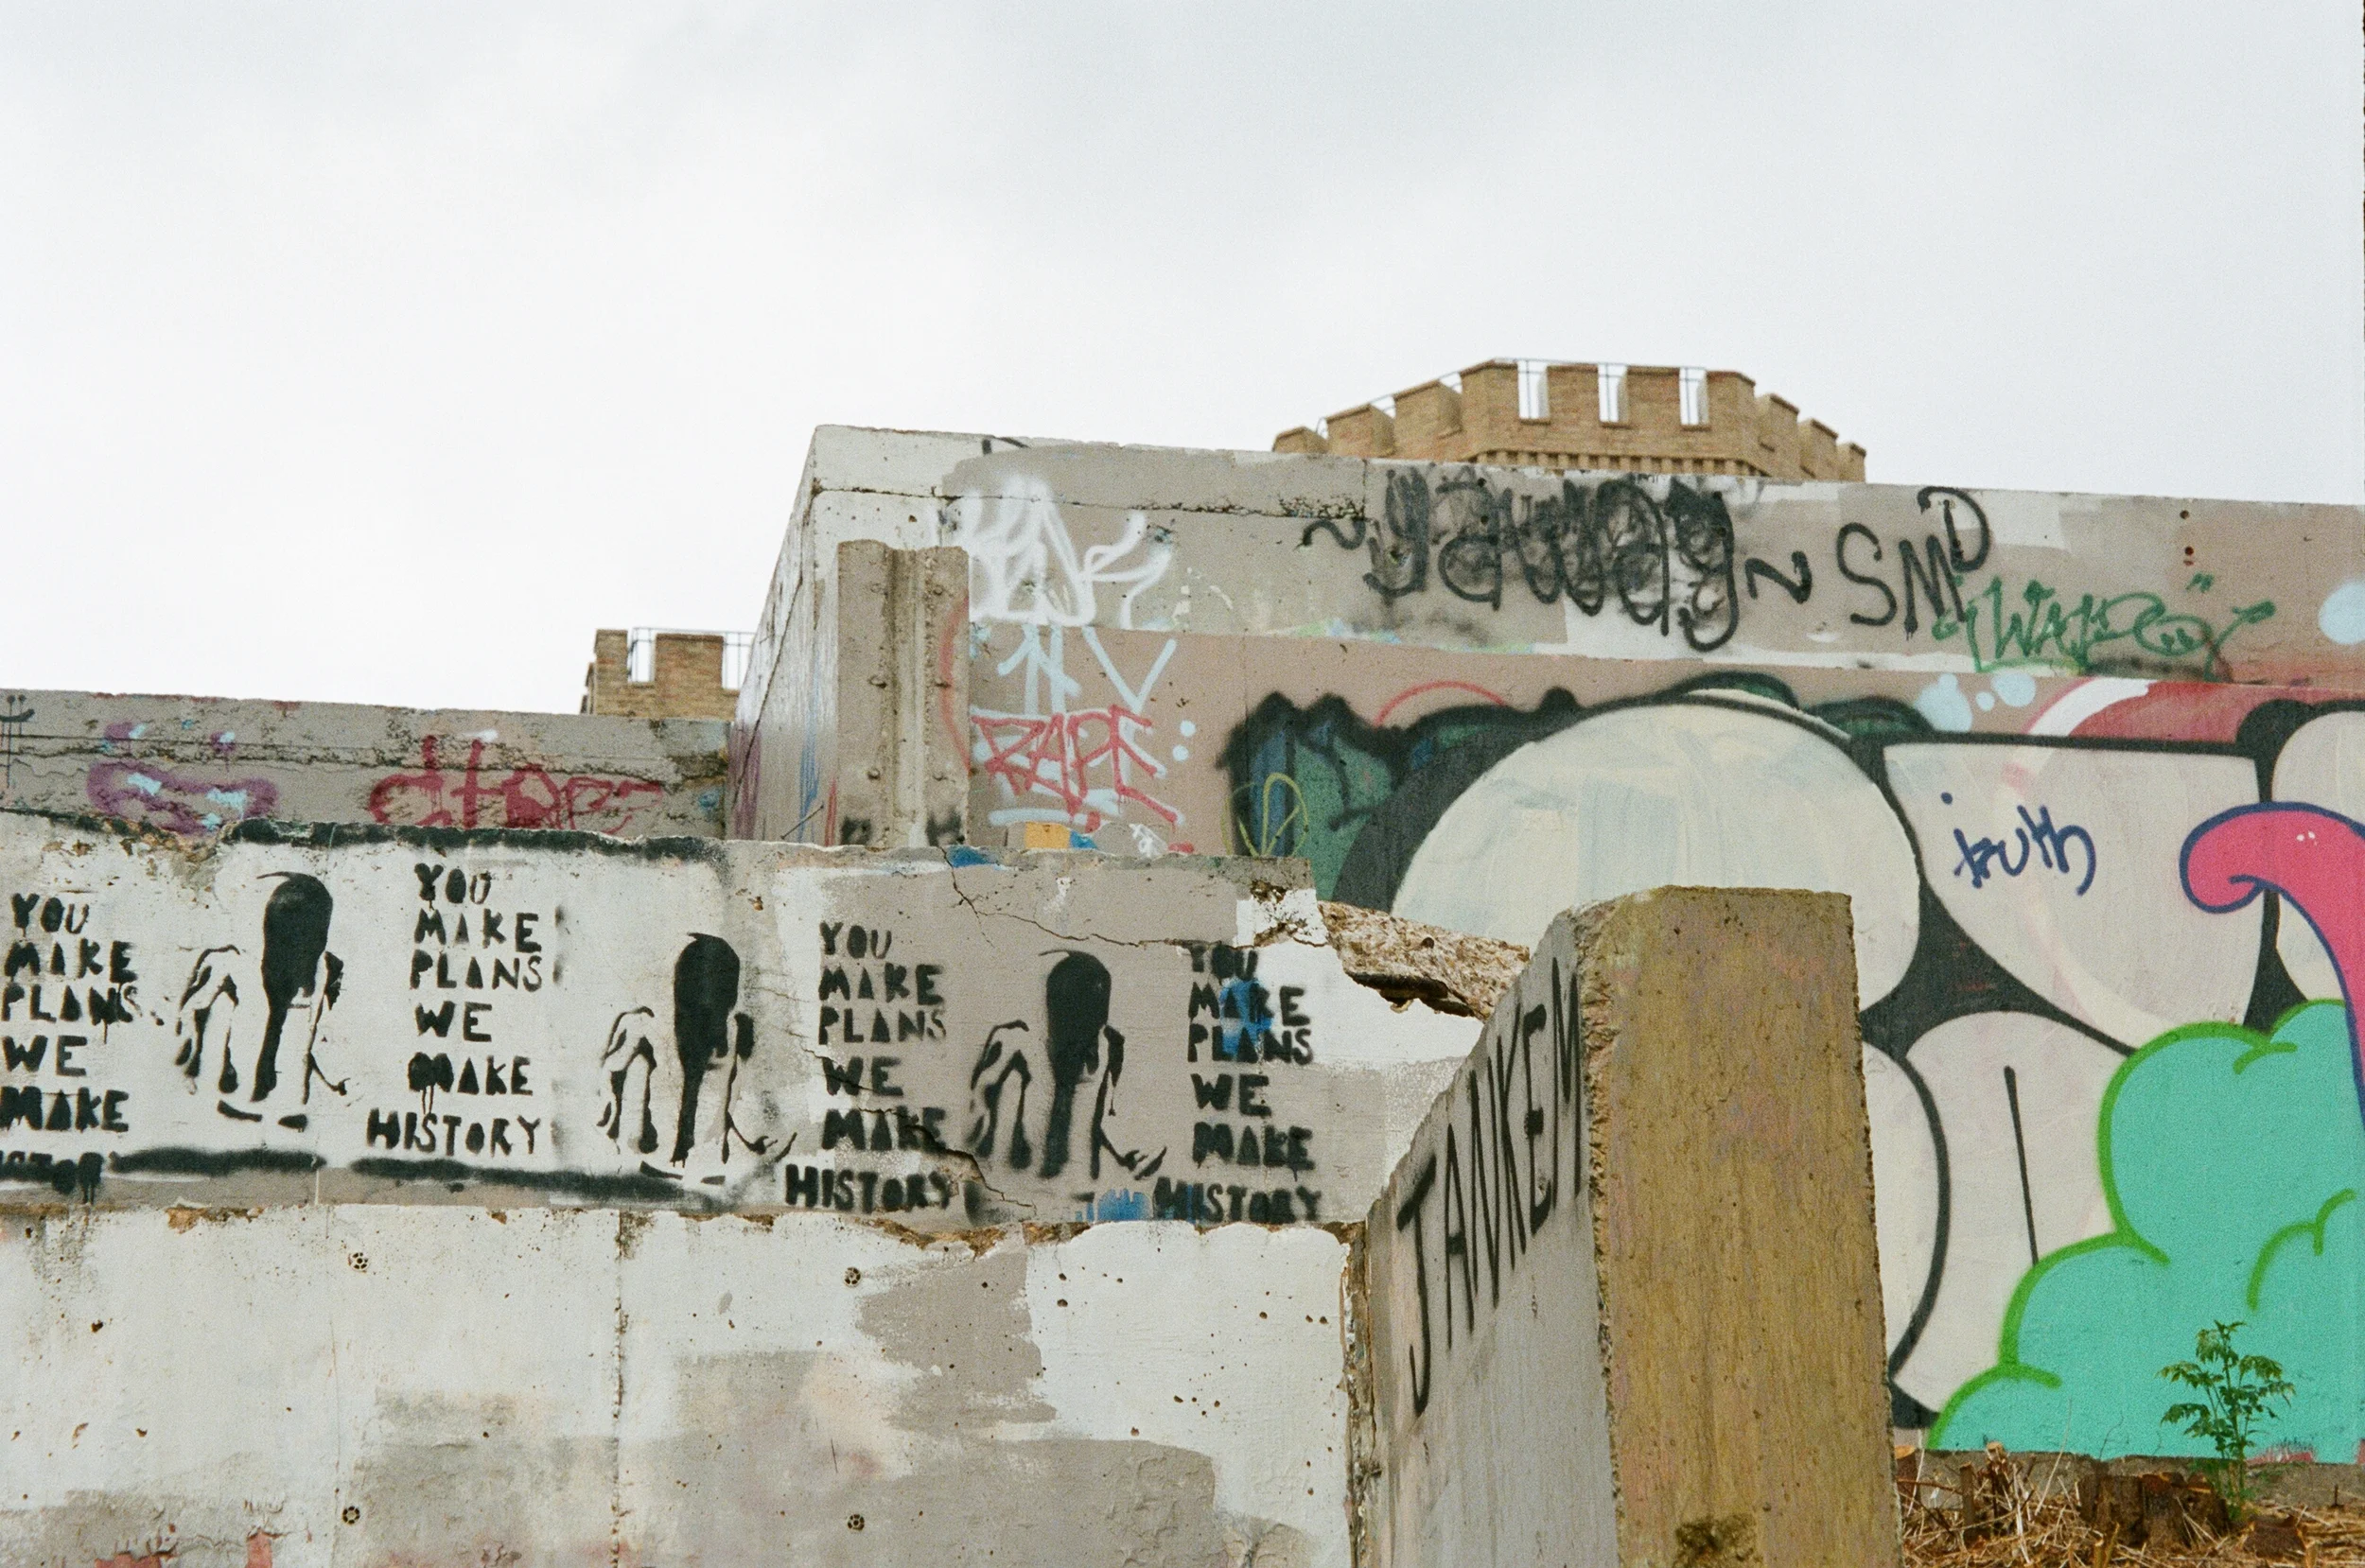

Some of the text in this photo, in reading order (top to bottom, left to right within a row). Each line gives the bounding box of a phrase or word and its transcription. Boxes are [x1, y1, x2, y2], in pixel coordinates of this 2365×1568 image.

[413, 862, 492, 905] YOU
[10, 893, 90, 934] YOU
[414, 908, 542, 953] MAKE
[3, 936, 138, 985] MAKE
[820, 921, 892, 959] YOU
[409, 949, 543, 992] PLANS
[818, 963, 944, 1005] MAKE
[414, 1001, 493, 1042] WE
[818, 1006, 947, 1045] PLANS
[1188, 982, 1311, 1026] MAKE
[0, 1034, 88, 1076] WE
[1187, 1021, 1314, 1066] PLANS
[408, 1052, 533, 1096] MAKE
[822, 1055, 903, 1096] WE
[1191, 1072, 1271, 1117] WE
[0, 1085, 130, 1133] MAKE
[821, 1106, 947, 1153] MAKE
[366, 1107, 540, 1156] HISTORY
[1192, 1121, 1315, 1171] MAKE
[1153, 1176, 1323, 1224] HISTORY
